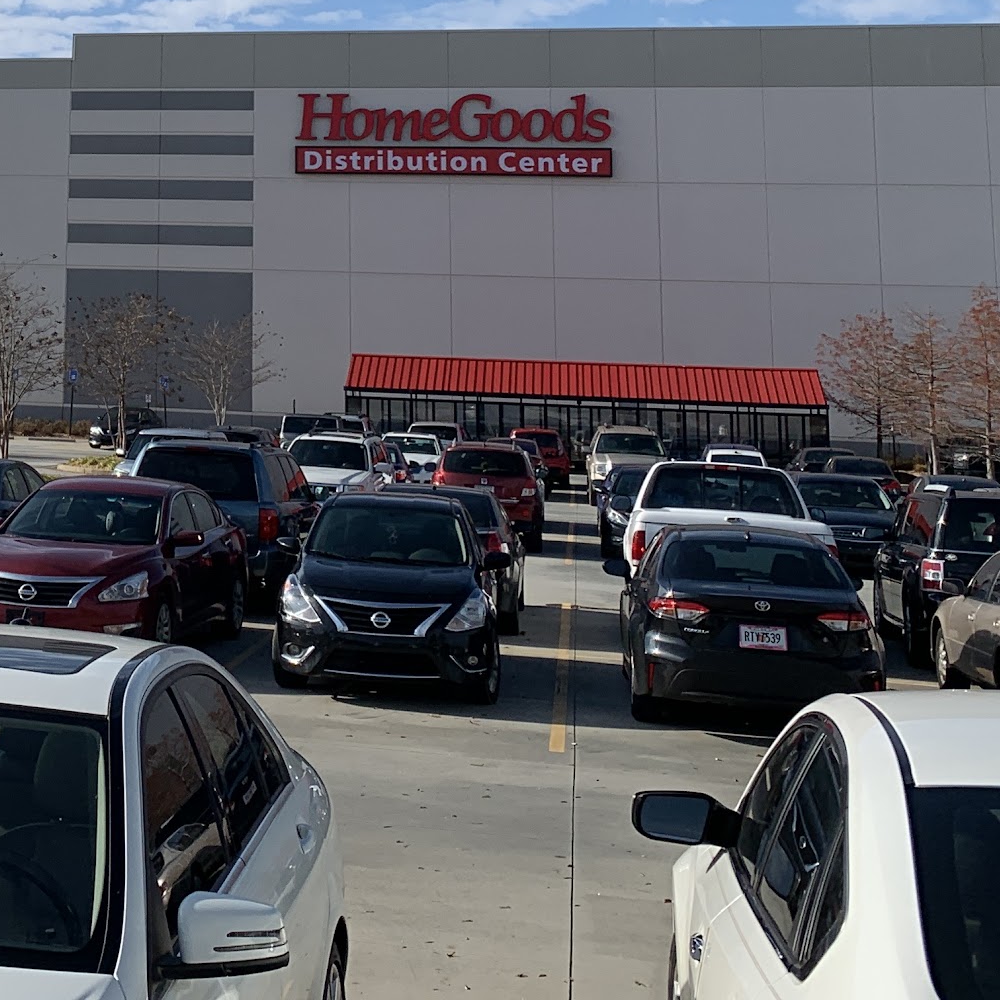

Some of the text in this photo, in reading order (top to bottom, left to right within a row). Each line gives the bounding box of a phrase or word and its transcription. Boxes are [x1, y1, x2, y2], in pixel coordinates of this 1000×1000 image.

[295, 93, 612, 143] HomeGoods
[304, 150, 603, 174] Distribution Center
[744, 630, 781, 644] RTY7539
